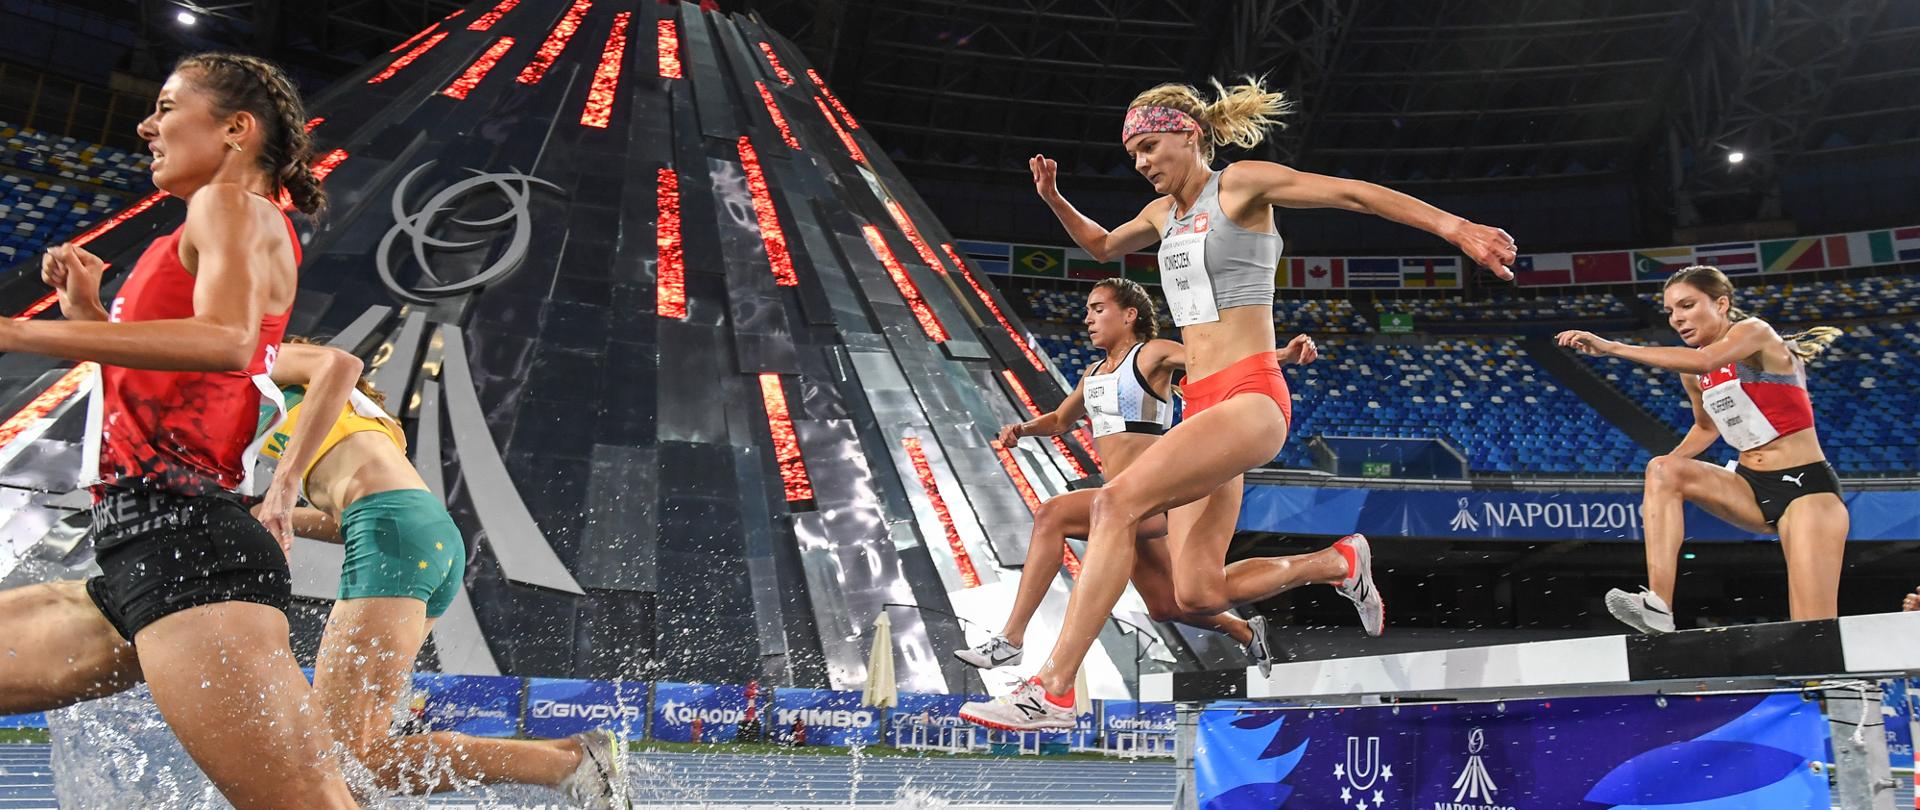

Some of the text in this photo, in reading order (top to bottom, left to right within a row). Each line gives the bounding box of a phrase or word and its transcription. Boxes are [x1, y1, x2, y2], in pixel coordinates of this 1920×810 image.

[551, 703, 639, 719] GIVOVA
[678, 706, 758, 725] QIAODA
[777, 708, 873, 728] KIMBO
